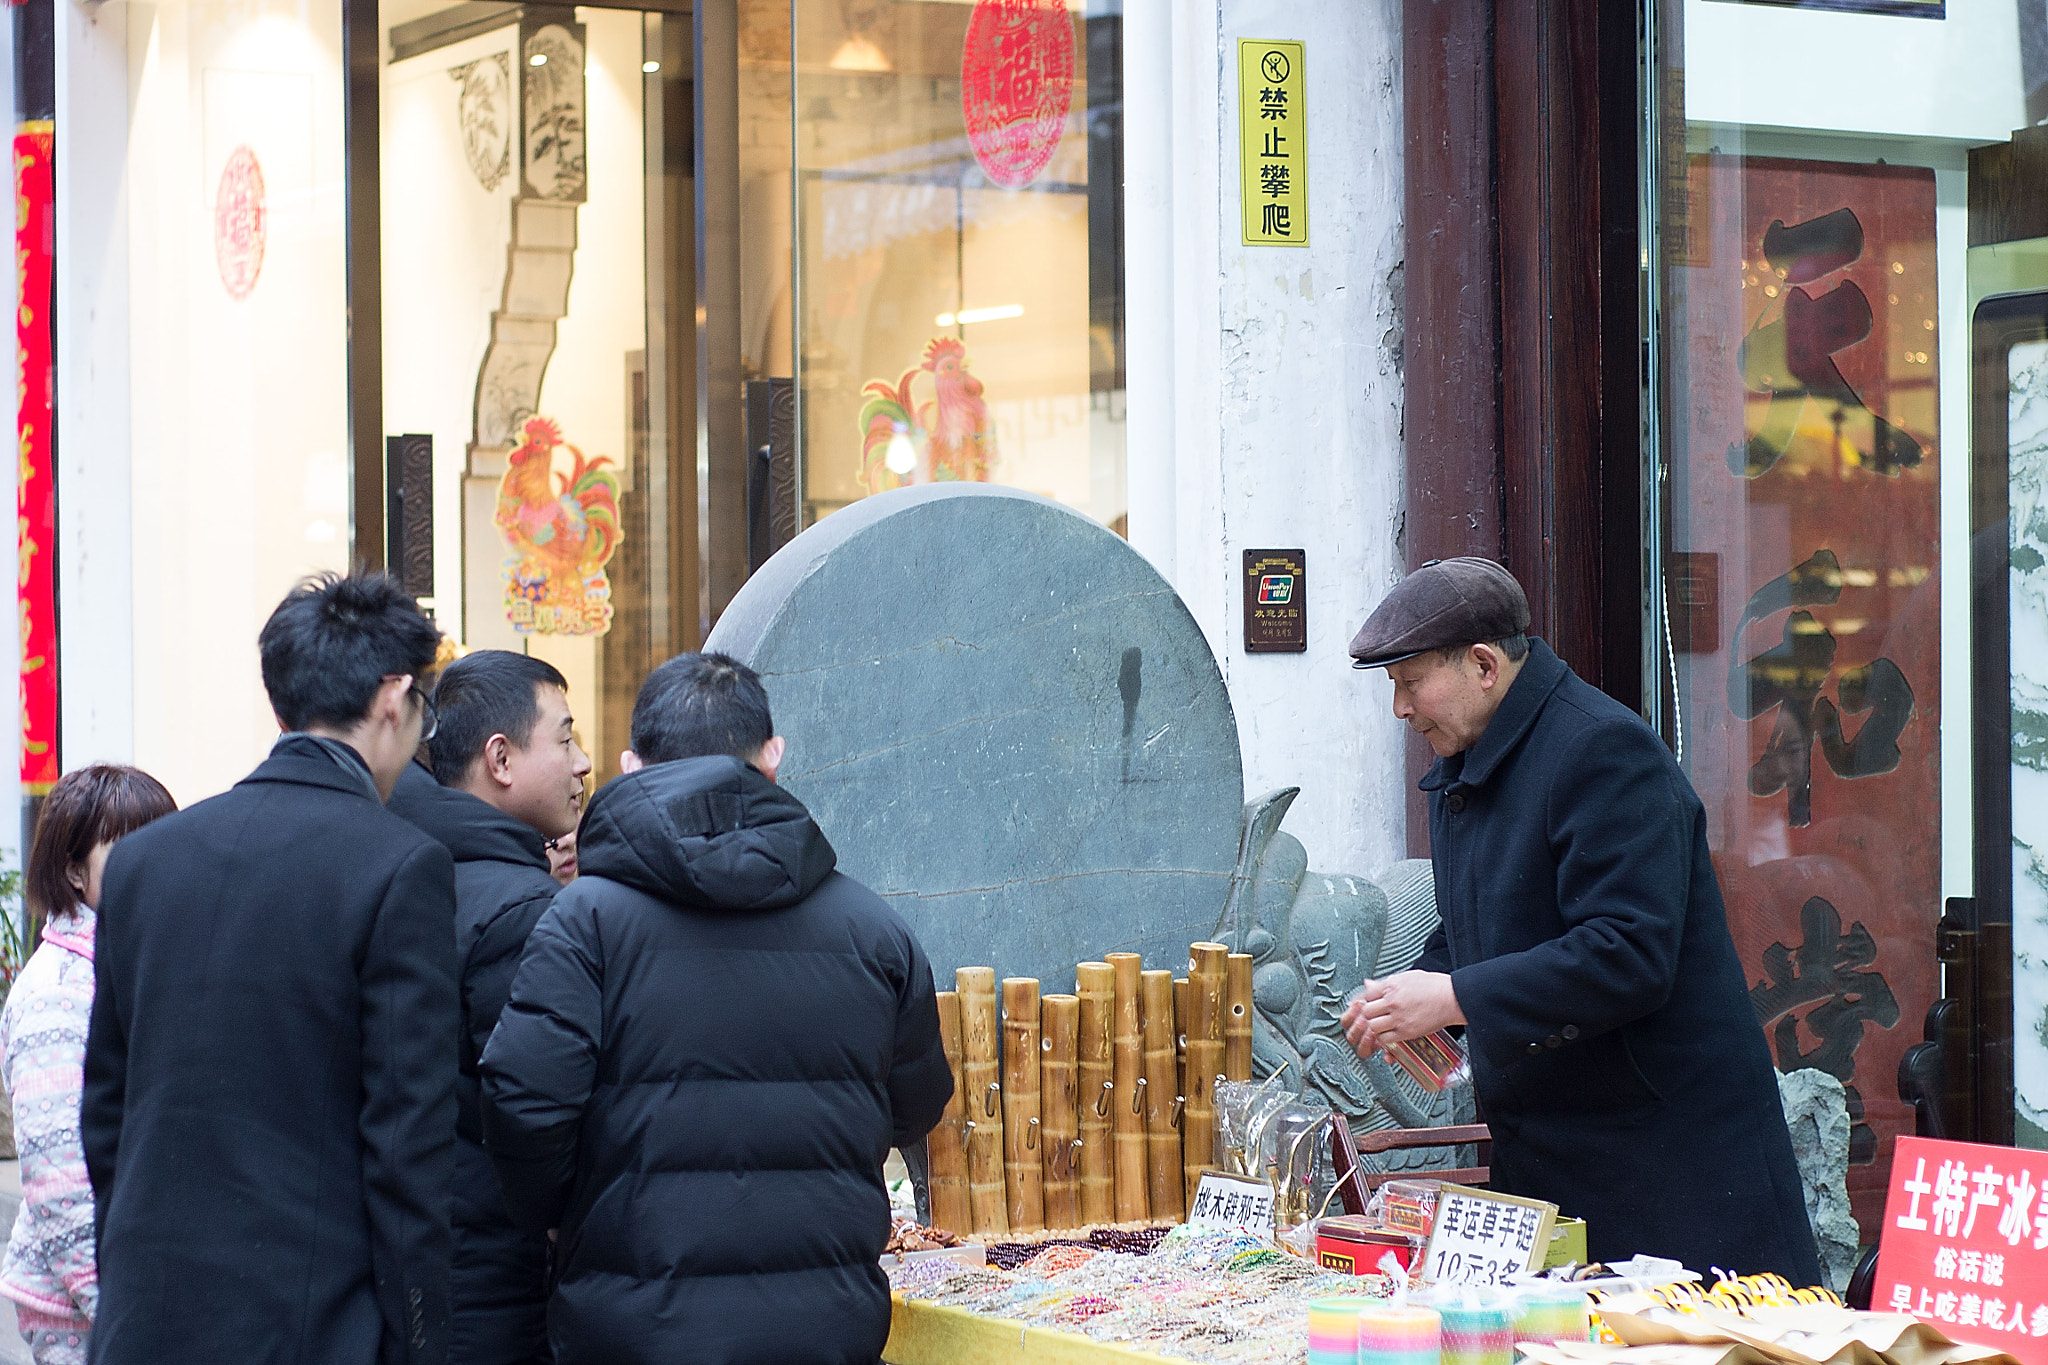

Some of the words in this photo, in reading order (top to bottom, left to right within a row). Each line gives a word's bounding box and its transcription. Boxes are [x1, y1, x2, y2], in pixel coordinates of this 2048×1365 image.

[1260, 87, 1291, 236] 禁止攀爬
[1262, 582, 1290, 593] UnionPay
[1254, 608, 1299, 618] 欢迎光临
[1194, 1186, 1274, 1229] 桃木辟邪手
[1443, 1197, 1538, 1252] 幸运草手链
[1436, 1250, 1521, 1288] 10元3条
[1934, 1246, 2005, 1287] 俗话说
